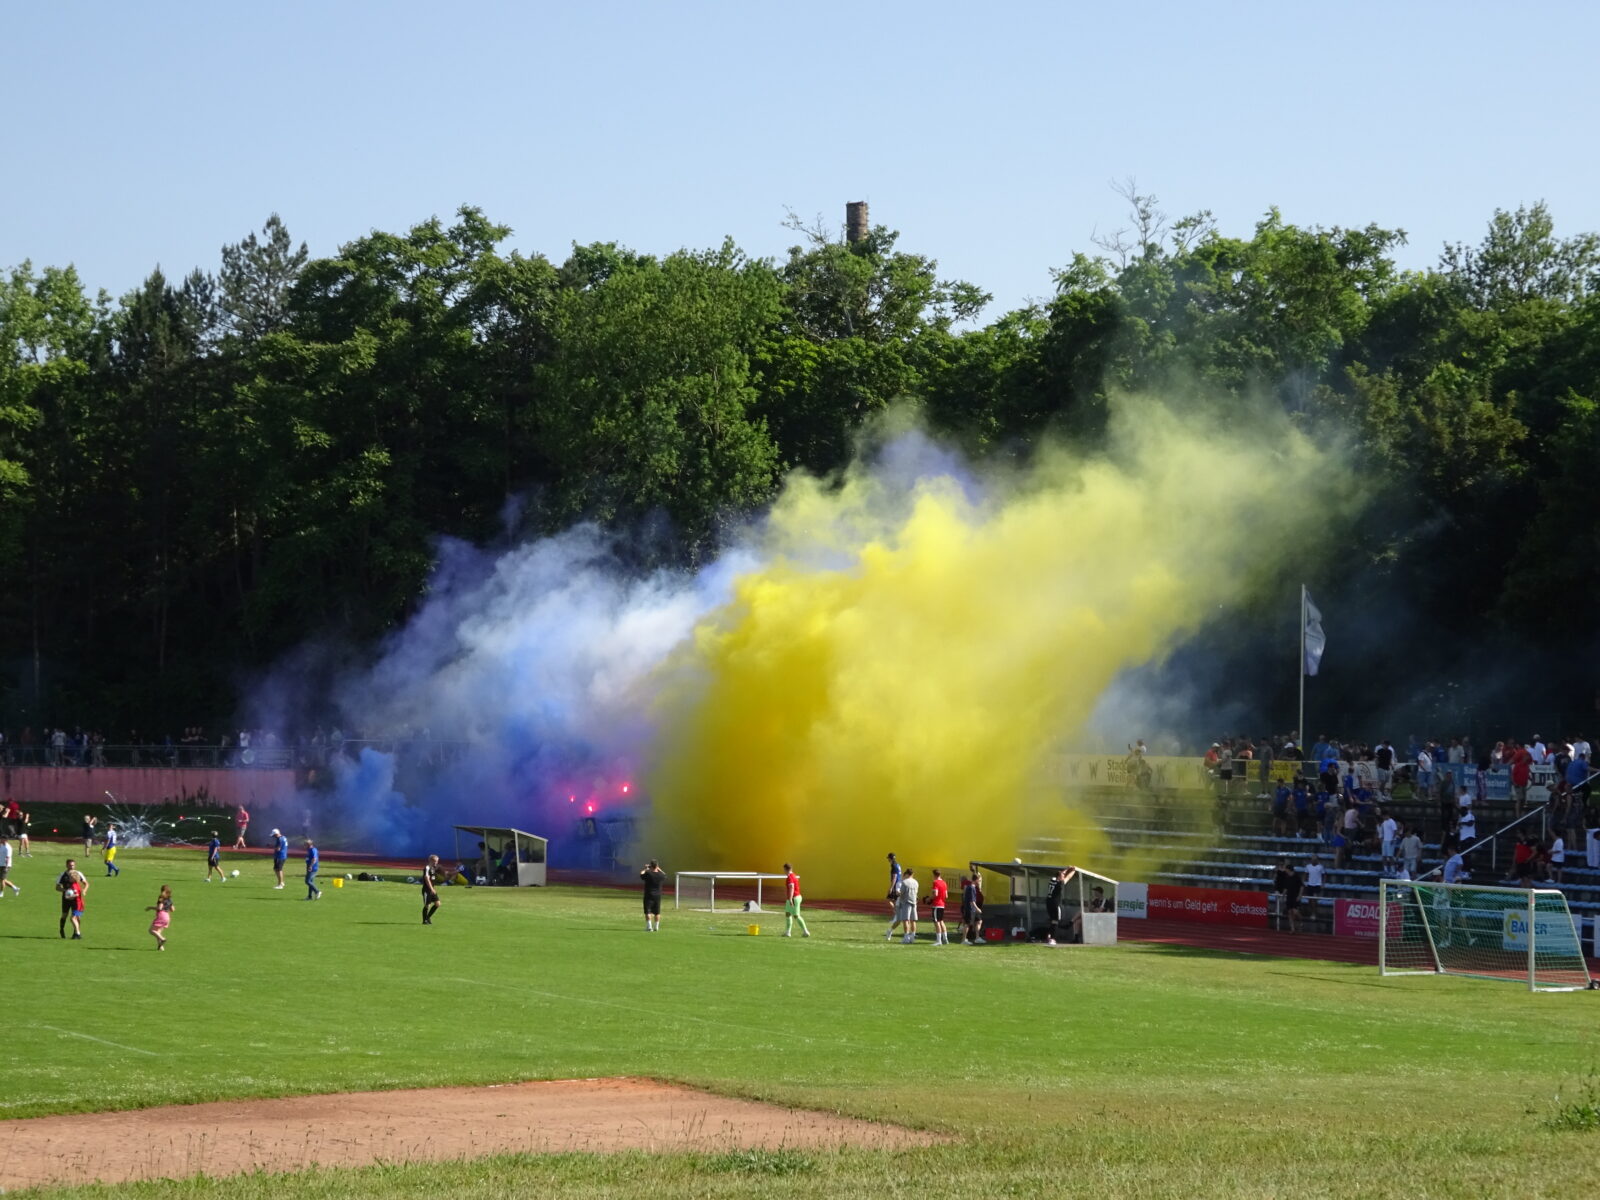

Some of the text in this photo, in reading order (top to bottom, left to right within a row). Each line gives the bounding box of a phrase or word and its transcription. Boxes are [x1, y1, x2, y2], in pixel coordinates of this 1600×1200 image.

[1149, 897, 1172, 909] wenn's
[1173, 900, 1184, 910] um
[1184, 898, 1201, 911] Geld
[1202, 901, 1218, 914] geht
[1230, 902, 1267, 916] Sparkasse
[1511, 920, 1547, 935] BAER
